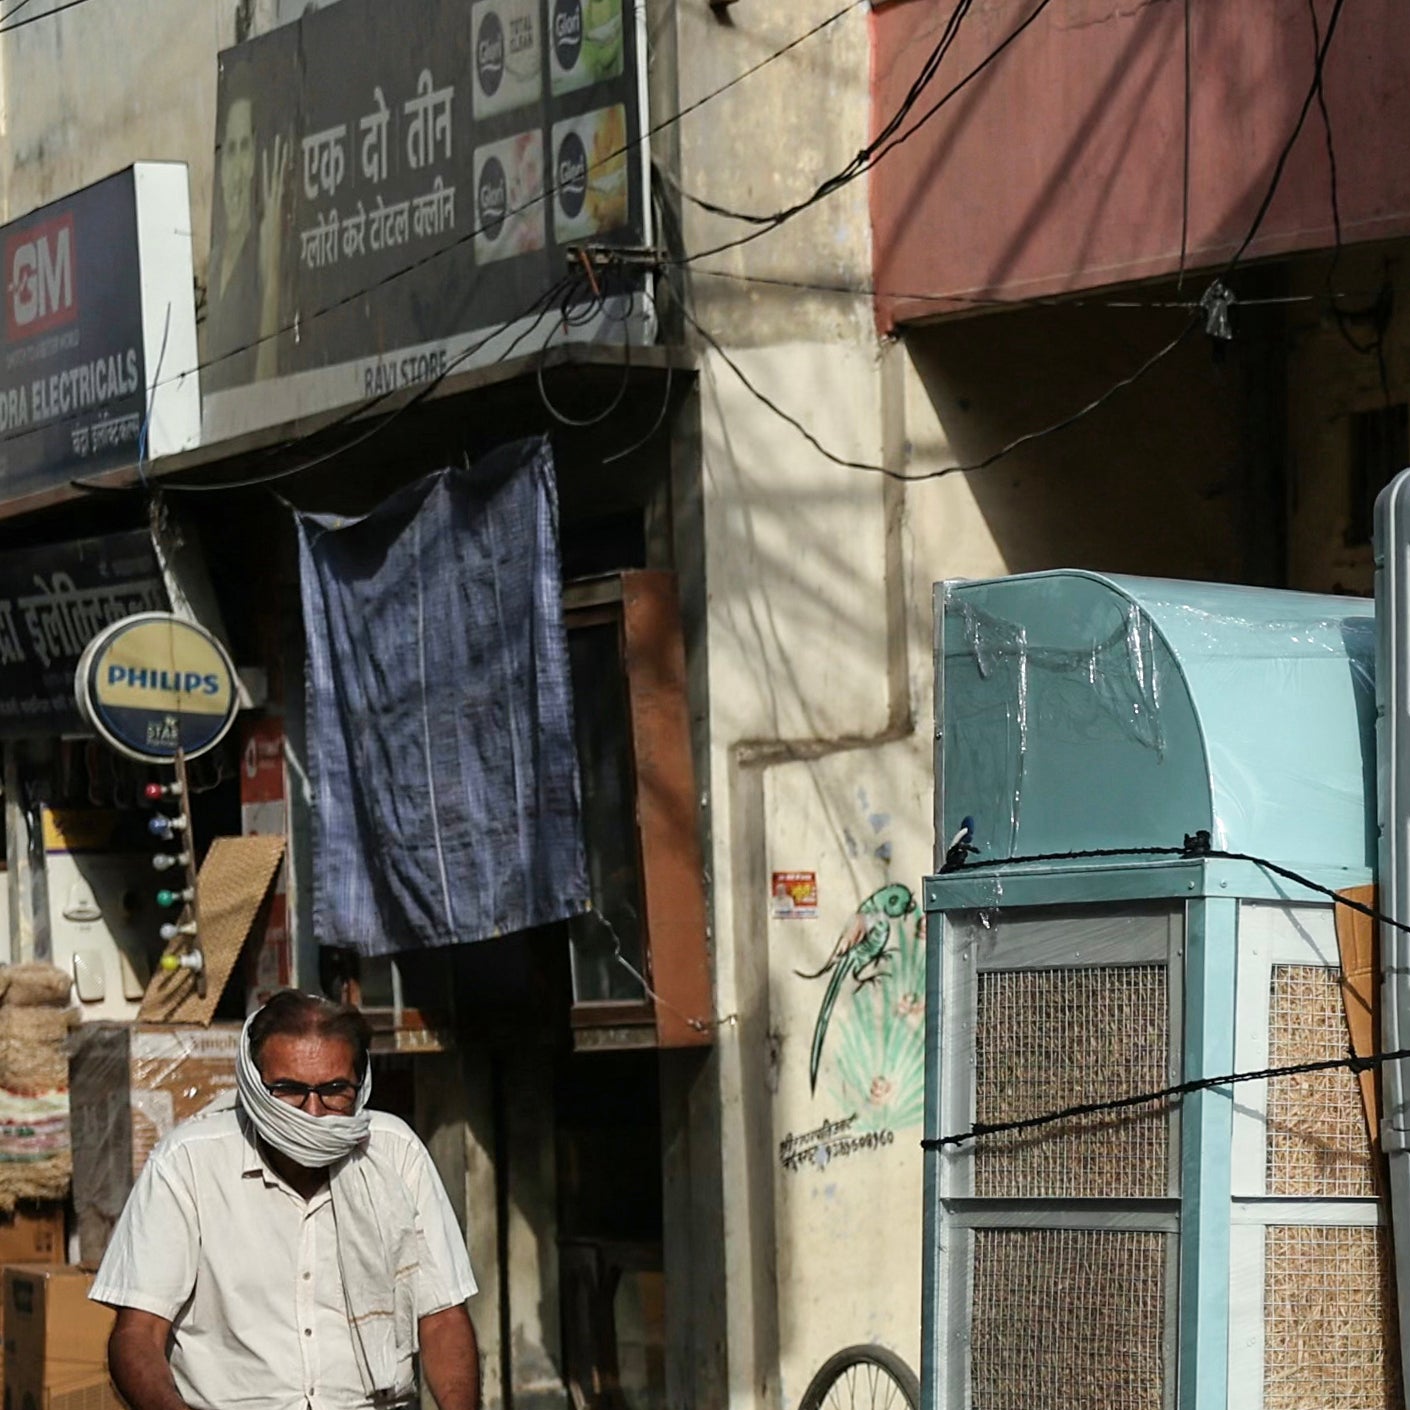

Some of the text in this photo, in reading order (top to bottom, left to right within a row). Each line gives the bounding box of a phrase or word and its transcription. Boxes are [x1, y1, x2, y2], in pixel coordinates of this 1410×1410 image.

[302, 68, 454, 199] एक दो तीन
[342, 200, 366, 257] करे
[369, 196, 411, 249] टोटल
[412, 175, 456, 237] क्लीन
[11, 227, 72, 327] GM
[32, 348, 138, 419] ELECTRICALS
[364, 350, 447, 397] RAVI STORE
[107, 664, 219, 695] PHILIPS
